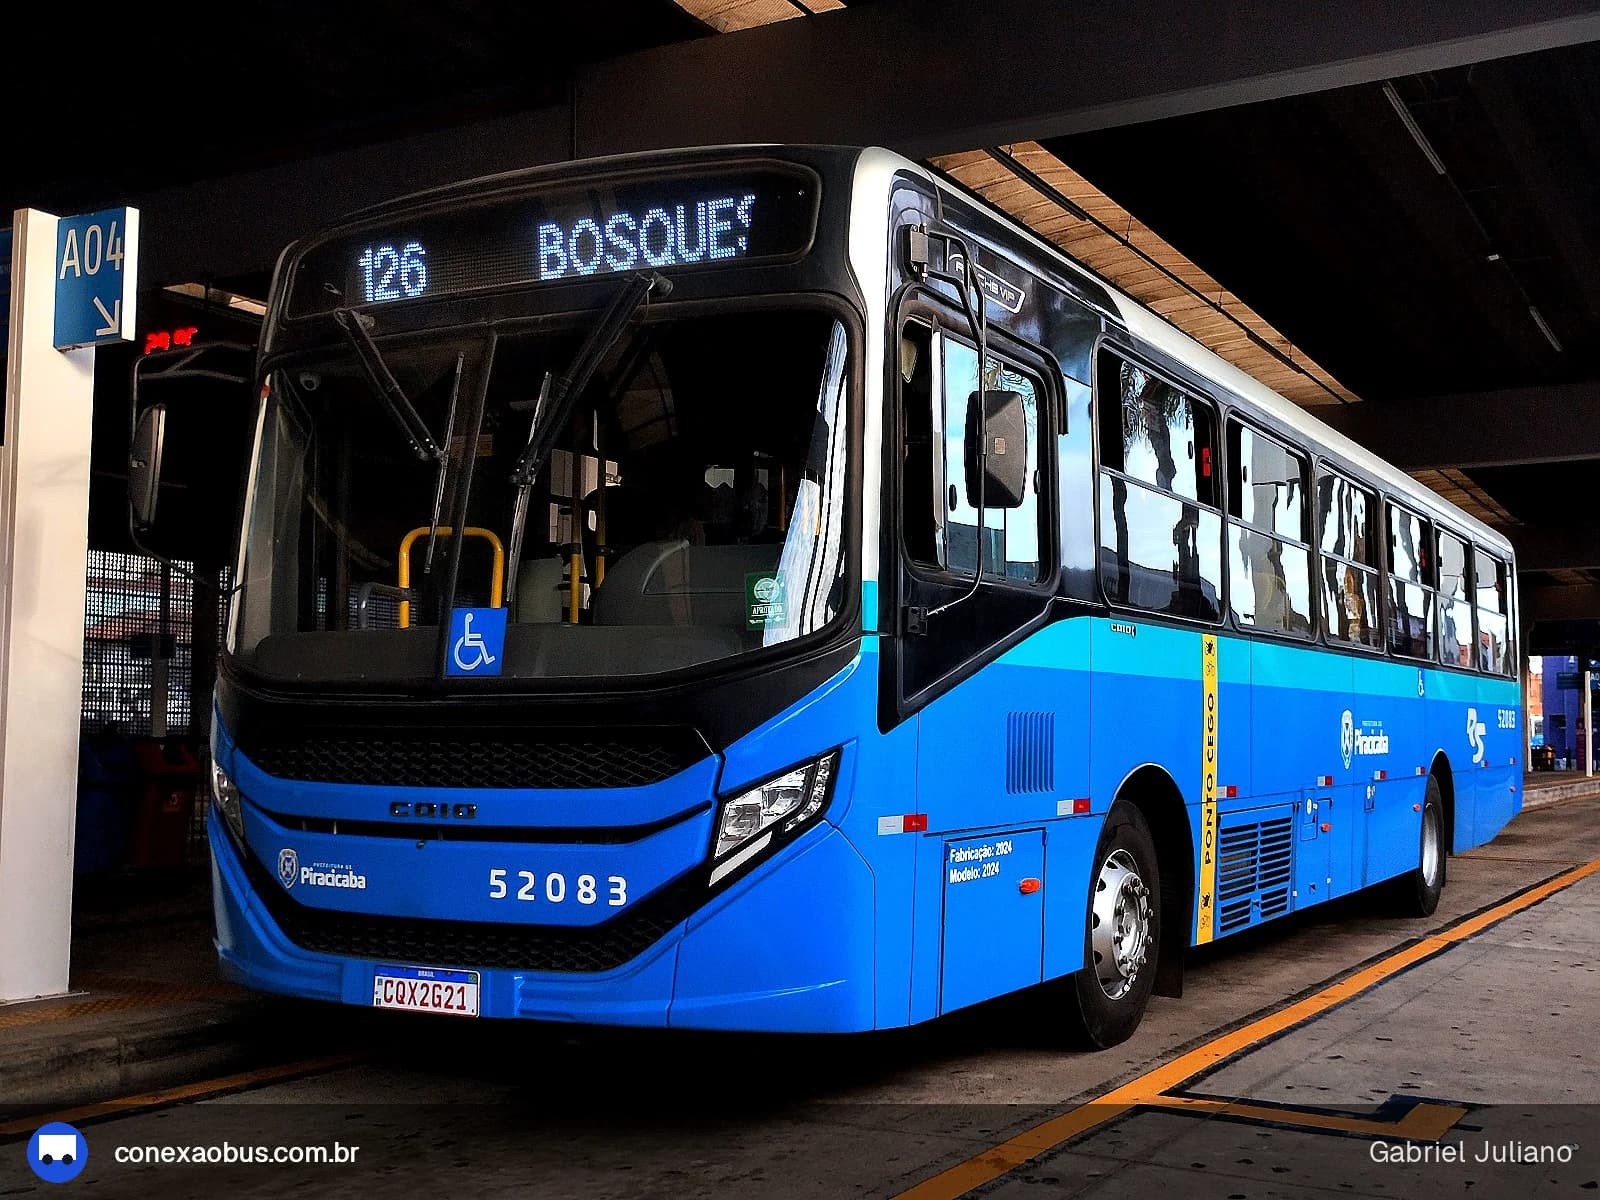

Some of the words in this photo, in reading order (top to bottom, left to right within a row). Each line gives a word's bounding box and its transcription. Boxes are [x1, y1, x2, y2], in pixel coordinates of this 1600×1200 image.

[60, 221, 123, 280] A04
[358, 242, 427, 302] 126
[1206, 693, 1214, 763] CEGO
[1497, 709, 1516, 729] 52083
[1204, 773, 1213, 865] PONTO
[950, 845, 994, 863] Fabricação:
[995, 840, 1013, 856] 2024
[301, 867, 366, 889] Piracicaba
[489, 868, 627, 906] 52083
[949, 865, 981, 884] Modelo:
[981, 861, 1000, 878] 2024
[384, 979, 467, 1011] CQX2G21
